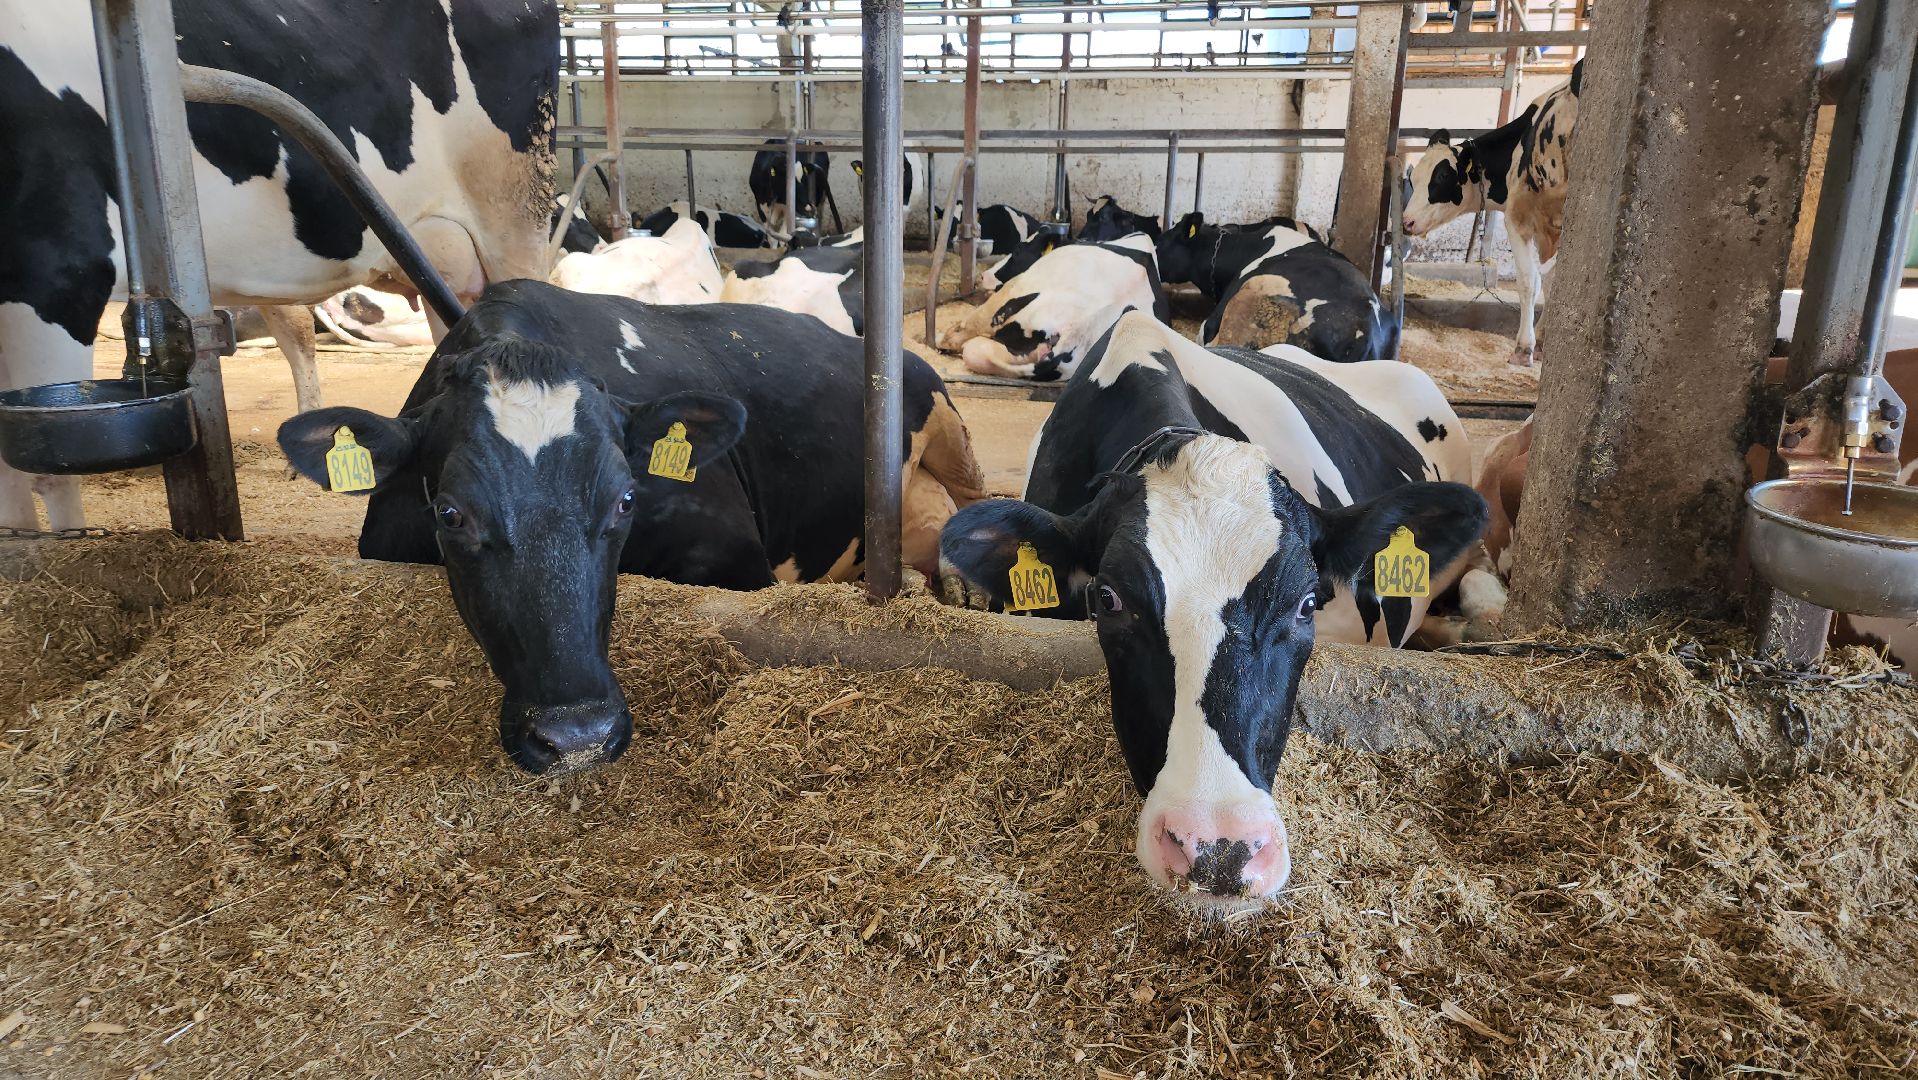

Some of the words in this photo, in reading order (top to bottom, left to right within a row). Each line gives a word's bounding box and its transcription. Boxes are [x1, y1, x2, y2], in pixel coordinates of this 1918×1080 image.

[331, 452, 372, 488] 8149
[652, 442, 688, 474] 8149
[1013, 567, 1057, 607] 8462
[1377, 554, 1426, 593] 8462
